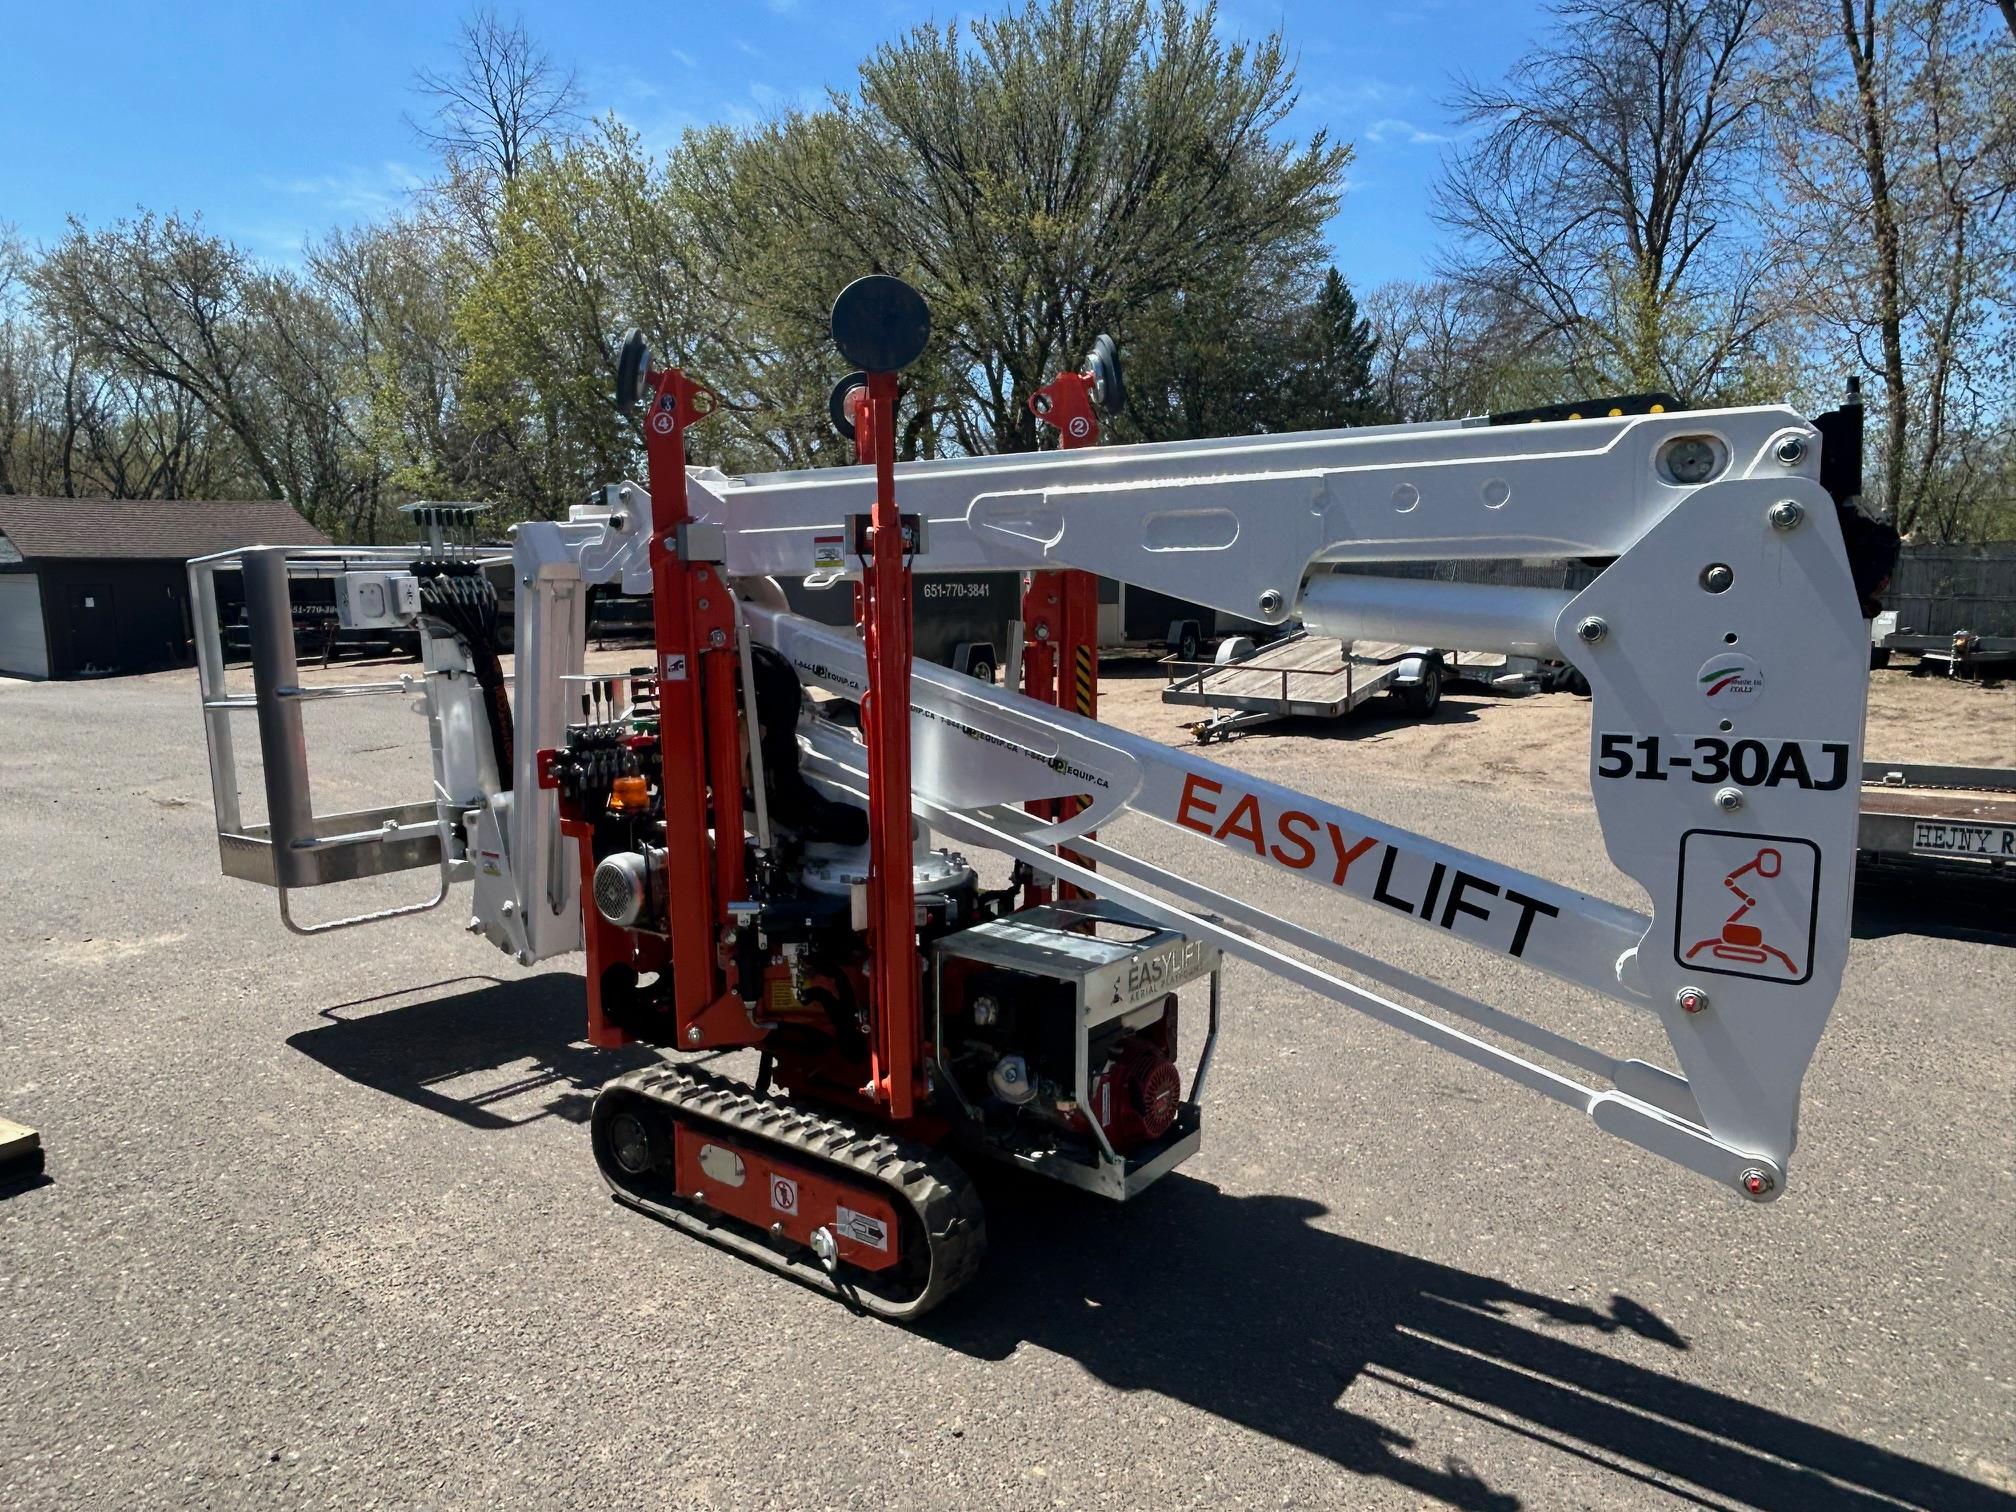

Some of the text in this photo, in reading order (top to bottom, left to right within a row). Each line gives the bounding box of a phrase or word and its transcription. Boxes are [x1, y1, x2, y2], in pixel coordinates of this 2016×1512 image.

[658, 416, 669, 430] 4
[1073, 419, 1085, 434] 2
[923, 583, 990, 598] 651-770-3841
[290, 605, 338, 615] 51-770-38
[1598, 734, 1850, 791] 51-30AJ
[1915, 824, 1992, 854] HEJNY
